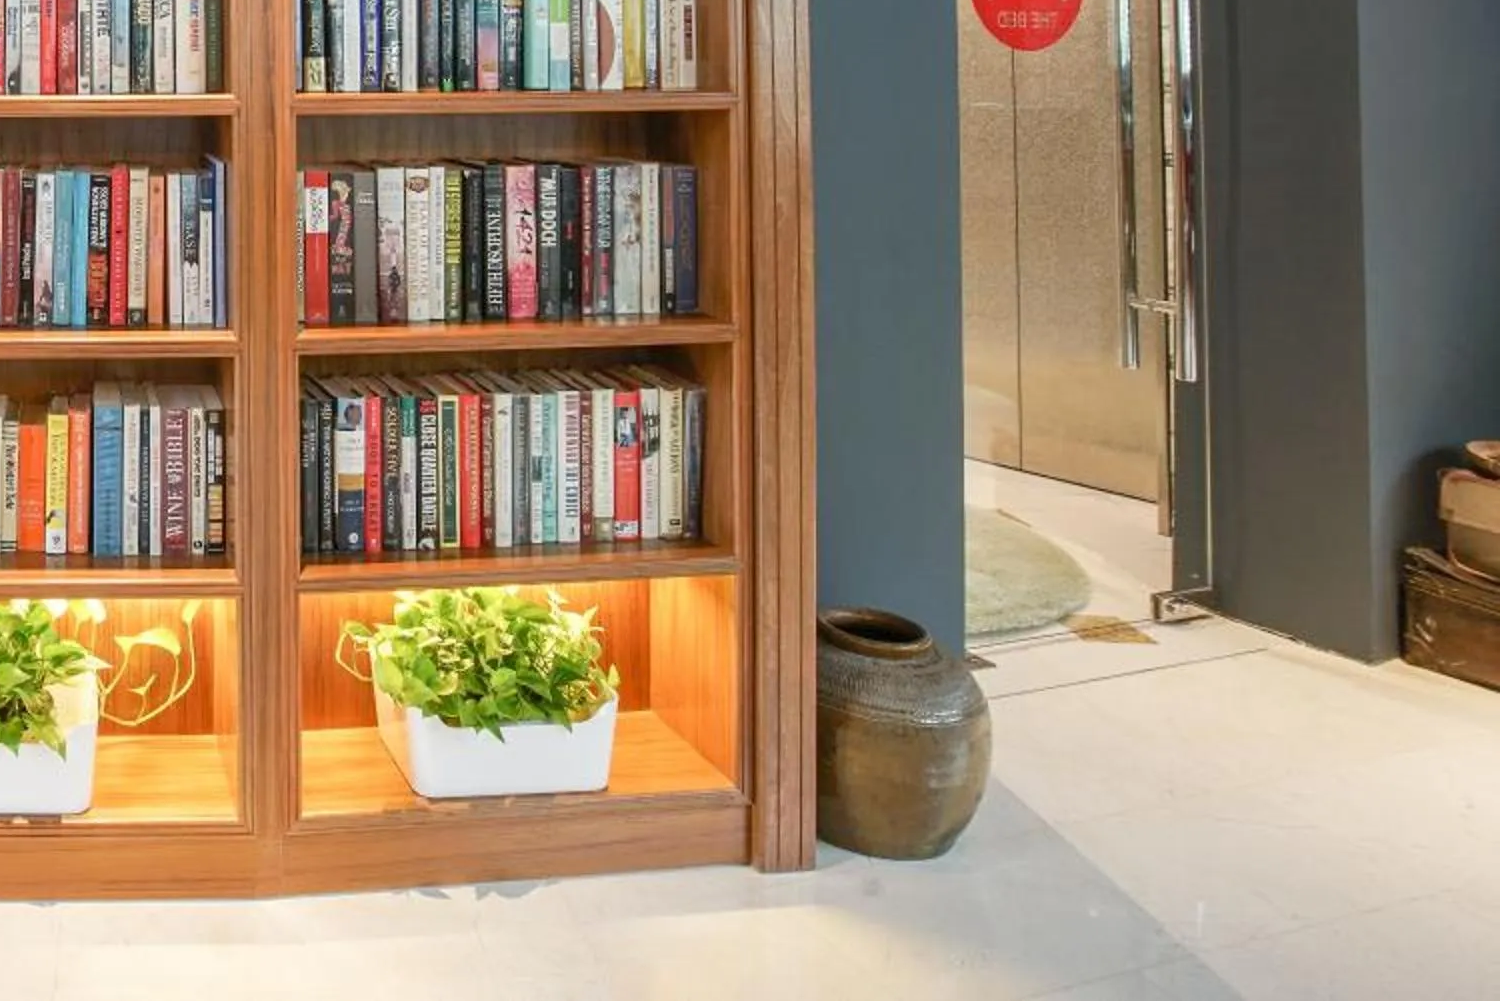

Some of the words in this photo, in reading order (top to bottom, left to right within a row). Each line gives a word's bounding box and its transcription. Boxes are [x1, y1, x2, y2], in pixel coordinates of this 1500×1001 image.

[516, 209, 532, 254] 1421
[541, 178, 556, 247] MURDOCH
[163, 417, 185, 472] BIBLE
[421, 415, 436, 447] CLOSE
[163, 492, 185, 538] WINE
[421, 497, 436, 531] BATTLE
